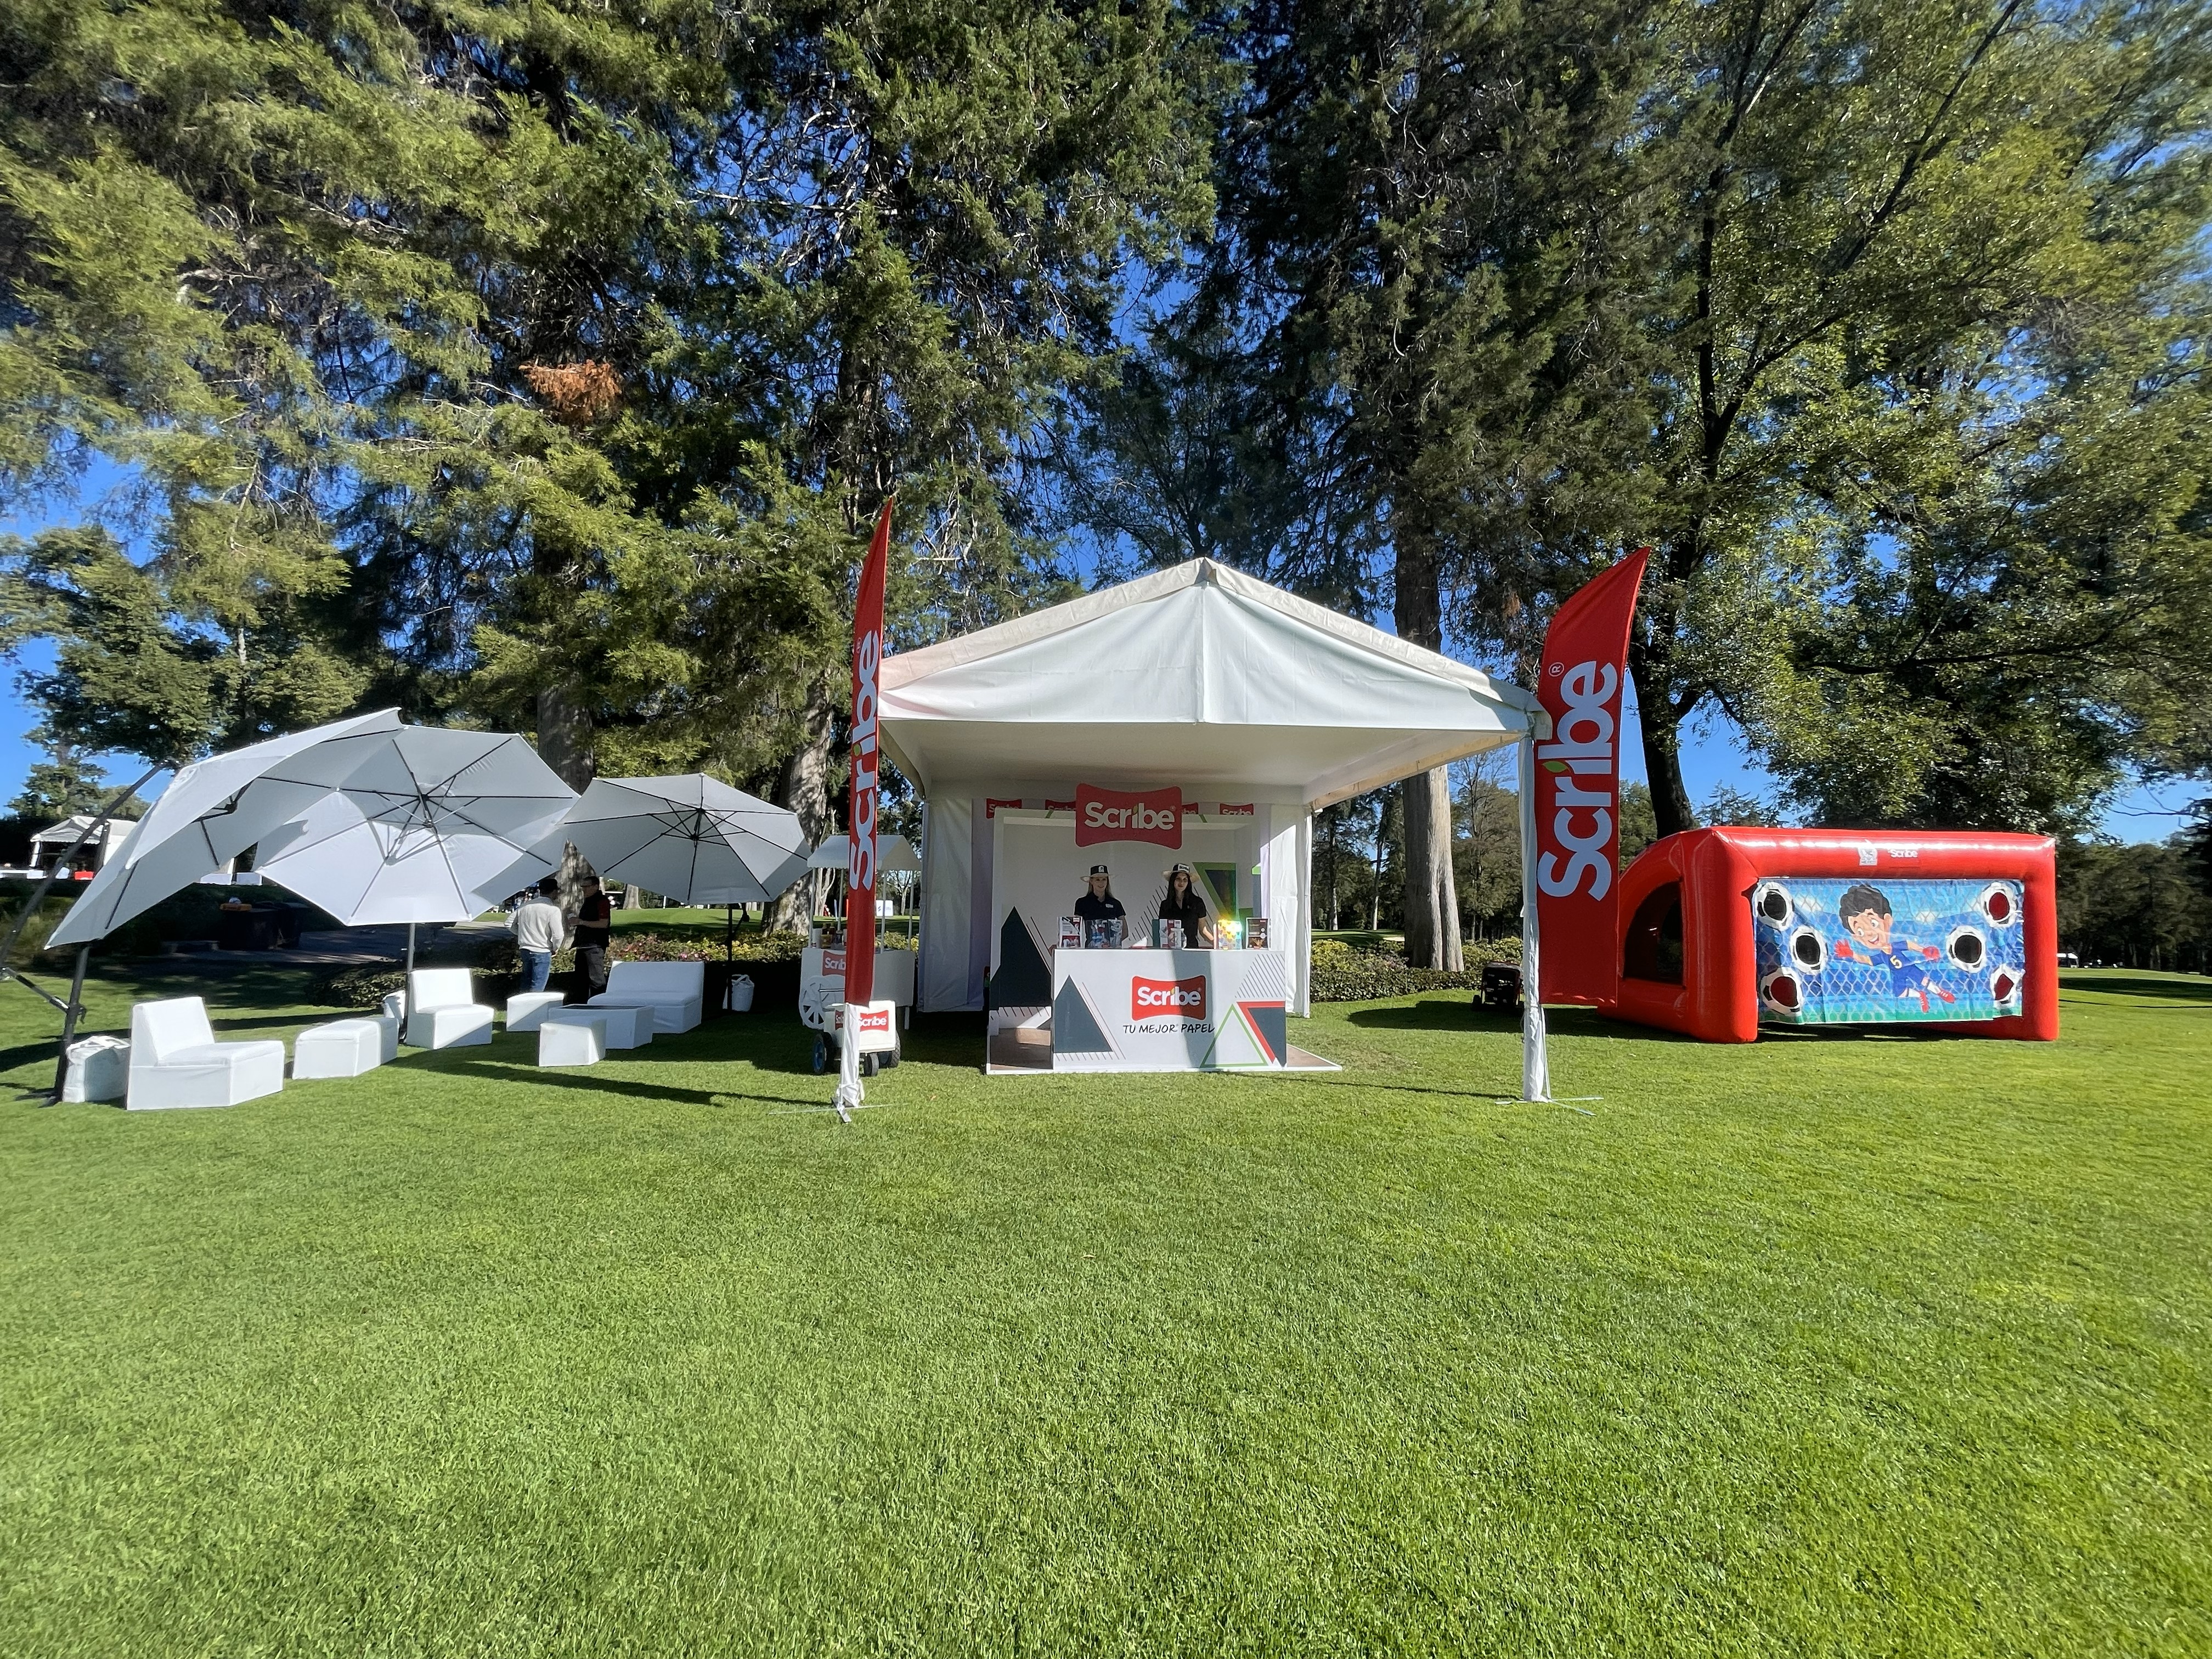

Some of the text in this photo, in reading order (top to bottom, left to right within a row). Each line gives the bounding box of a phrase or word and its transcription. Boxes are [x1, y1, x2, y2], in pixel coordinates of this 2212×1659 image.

[849, 630, 879, 891] Scribe
[1537, 660, 1617, 901] Scribe
[1084, 802, 1175, 830] Scribe
[825, 957, 847, 970] Scrib
[1890, 955, 1903, 969] 5
[1137, 986, 1201, 1006] Scribe
[1123, 1024, 1215, 1034] TU MEJOR PAPEL
